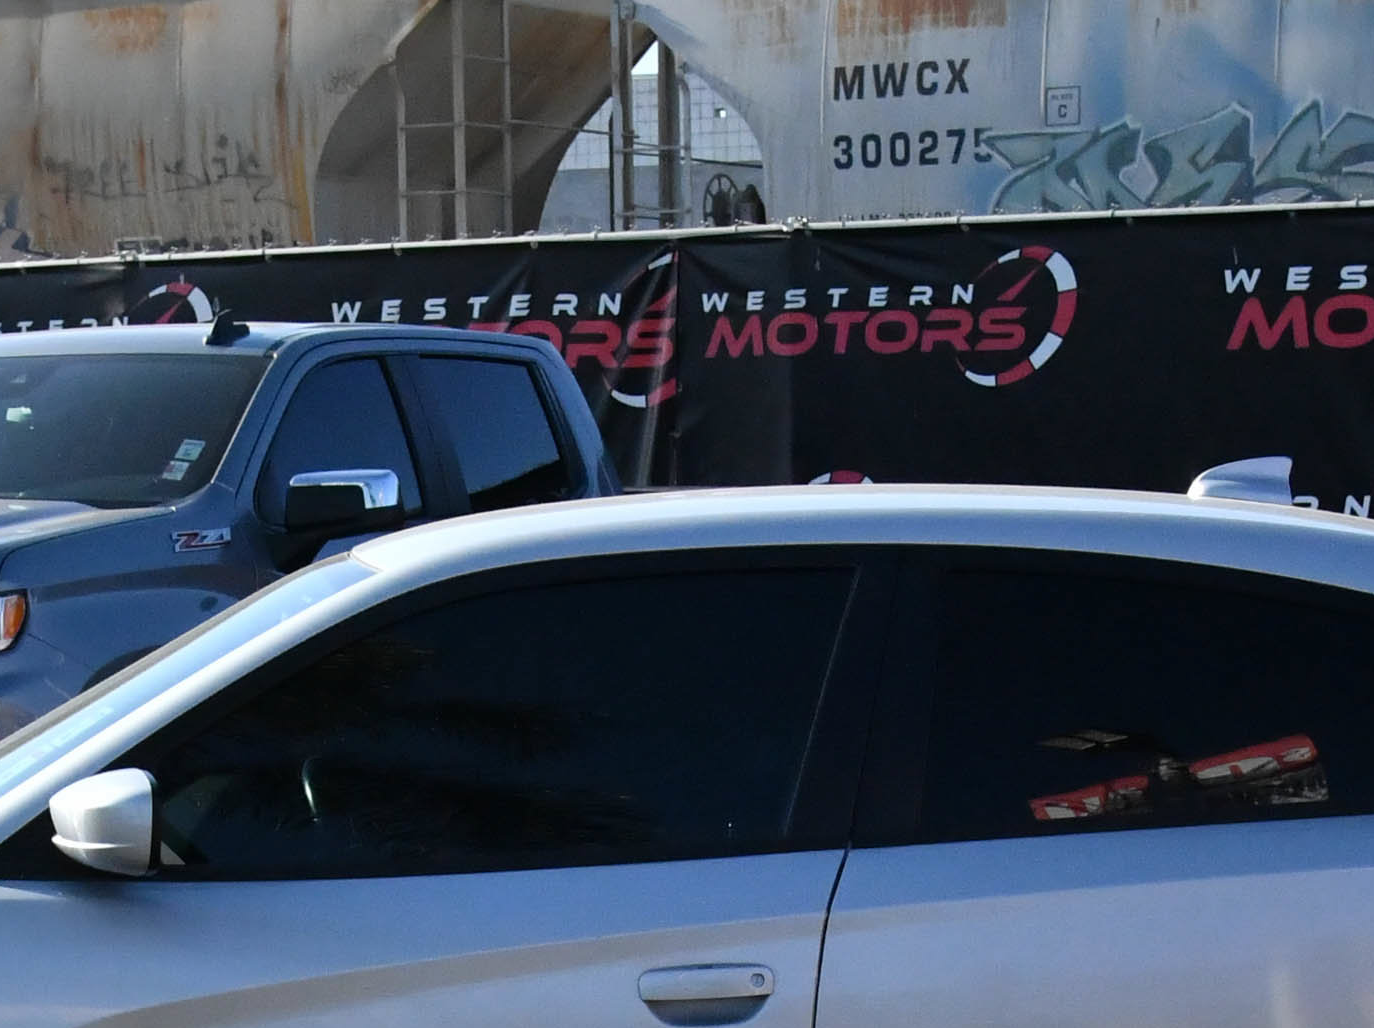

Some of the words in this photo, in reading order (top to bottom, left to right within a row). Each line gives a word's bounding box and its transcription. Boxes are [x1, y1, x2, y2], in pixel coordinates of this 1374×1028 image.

[833, 58, 971, 101] MWCX
[1058, 104, 1067, 118] C
[833, 127, 993, 170] 300275
[331, 292, 622, 323] WESTERN
[701, 283, 974, 313] WESTERN
[705, 306, 1027, 359] MOTORS
